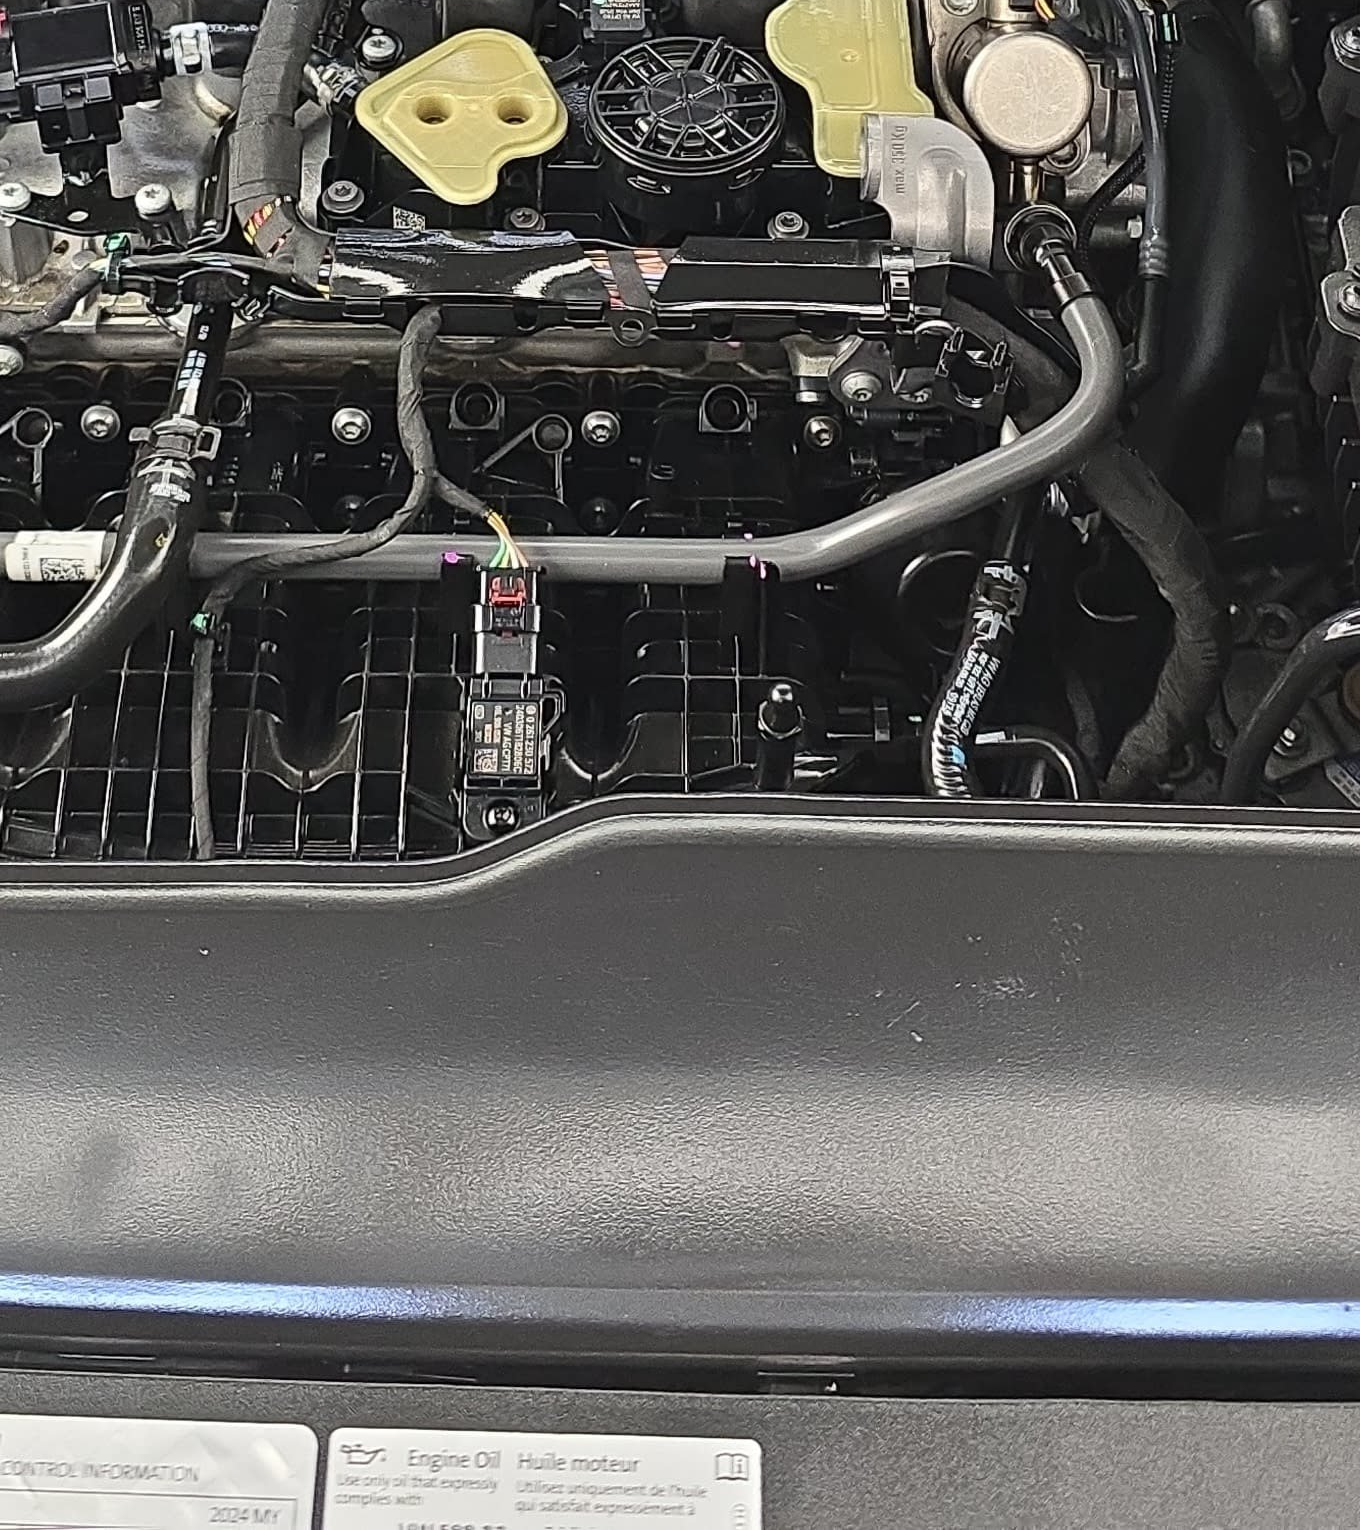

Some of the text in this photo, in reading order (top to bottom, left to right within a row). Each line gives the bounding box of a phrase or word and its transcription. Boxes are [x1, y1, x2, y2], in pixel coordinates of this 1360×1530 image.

[891, 143, 905, 164] 350
[407, 1447, 502, 1473] Engine Oil
[517, 1451, 641, 1473] Huile moteur
[0, 1459, 76, 1479] CONTROL
[84, 1462, 201, 1483] INFORMATION
[334, 1491, 392, 1508] complies
[209, 1506, 284, 1526] 2024 MY
